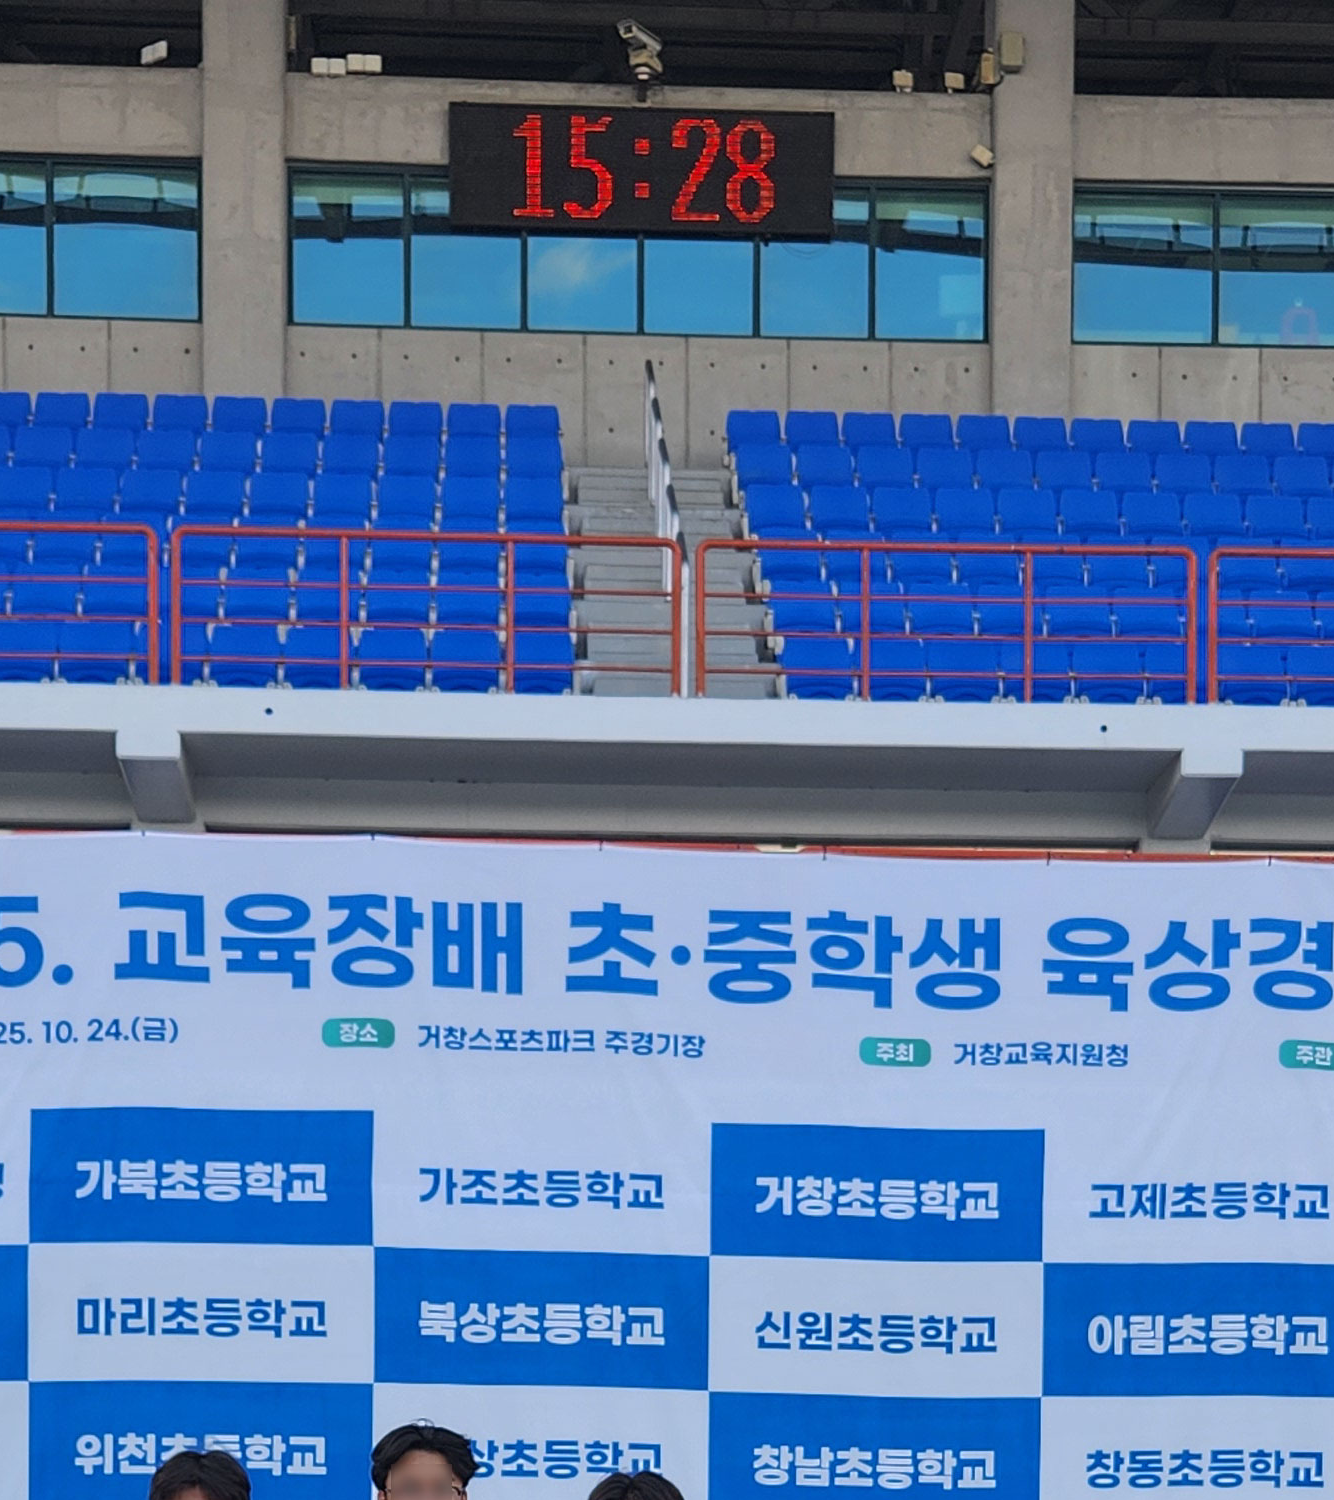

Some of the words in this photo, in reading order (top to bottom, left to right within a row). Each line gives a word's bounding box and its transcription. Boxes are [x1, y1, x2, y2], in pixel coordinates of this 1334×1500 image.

[513, 115, 775, 222] 15:28
[114, 891, 522, 995] 교육장배
[566, 902, 1000, 1010] 초·중학생
[42, 1021, 78, 1043] 10.
[88, 1017, 178, 1043] 24.(금)
[338, 1021, 380, 1045] 장소
[419, 1026, 595, 1052] 거창스포츠파크
[605, 1031, 705, 1058] 주경기장
[875, 1041, 915, 1067] 주최
[955, 1042, 1128, 1067] 거창교육지원청
[1295, 1045, 1334, 1068] 주관
[76, 1160, 327, 1202] 가북초등학교
[420, 1168, 664, 1209] 가조초등학교
[756, 1176, 999, 1221] 거창초등학교
[1090, 1182, 1329, 1219] 고제초등학교
[78, 1297, 327, 1338] 마리초등학교
[419, 1301, 665, 1346] 북상초등학교
[756, 1312, 997, 1354] 신원초등학교
[1088, 1314, 1328, 1355] 아림초등학교
[472, 1439, 663, 1480] 상초등학교
[753, 1445, 996, 1490] 창남초등학교
[1087, 1450, 1324, 1488] 창동초등학교
